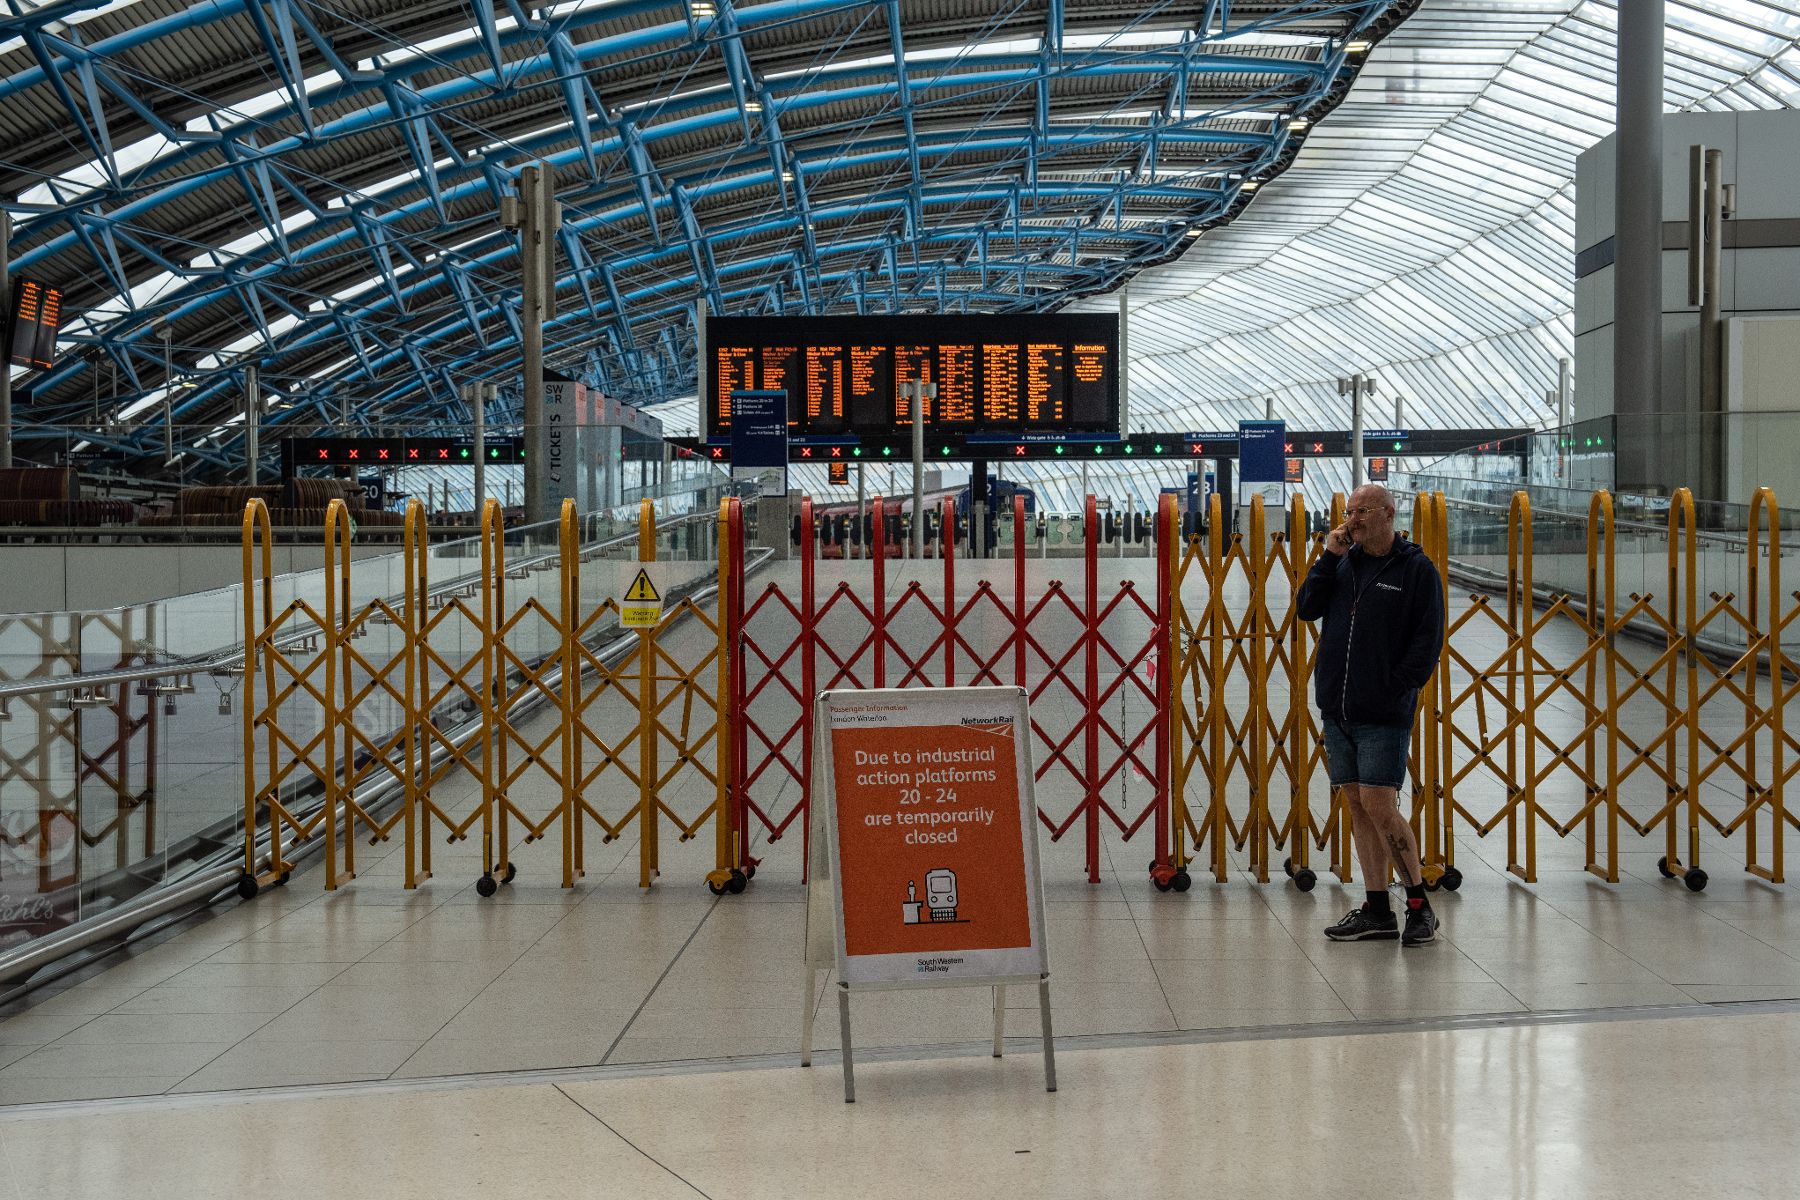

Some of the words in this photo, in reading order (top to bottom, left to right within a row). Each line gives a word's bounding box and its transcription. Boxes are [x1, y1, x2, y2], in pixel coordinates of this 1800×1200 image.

[550, 414, 560, 470] TICKETS
[361, 485, 378, 498] 20
[855, 750, 889, 765] Due
[893, 751, 911, 764] to
[916, 746, 995, 763] industrial
[857, 769, 910, 785] action
[915, 768, 996, 787] platforms
[900, 790, 920, 804] 20
[936, 788, 957, 803] 24
[865, 813, 892, 826] are
[896, 808, 994, 827] temporarily
[905, 828, 958, 844] closed
